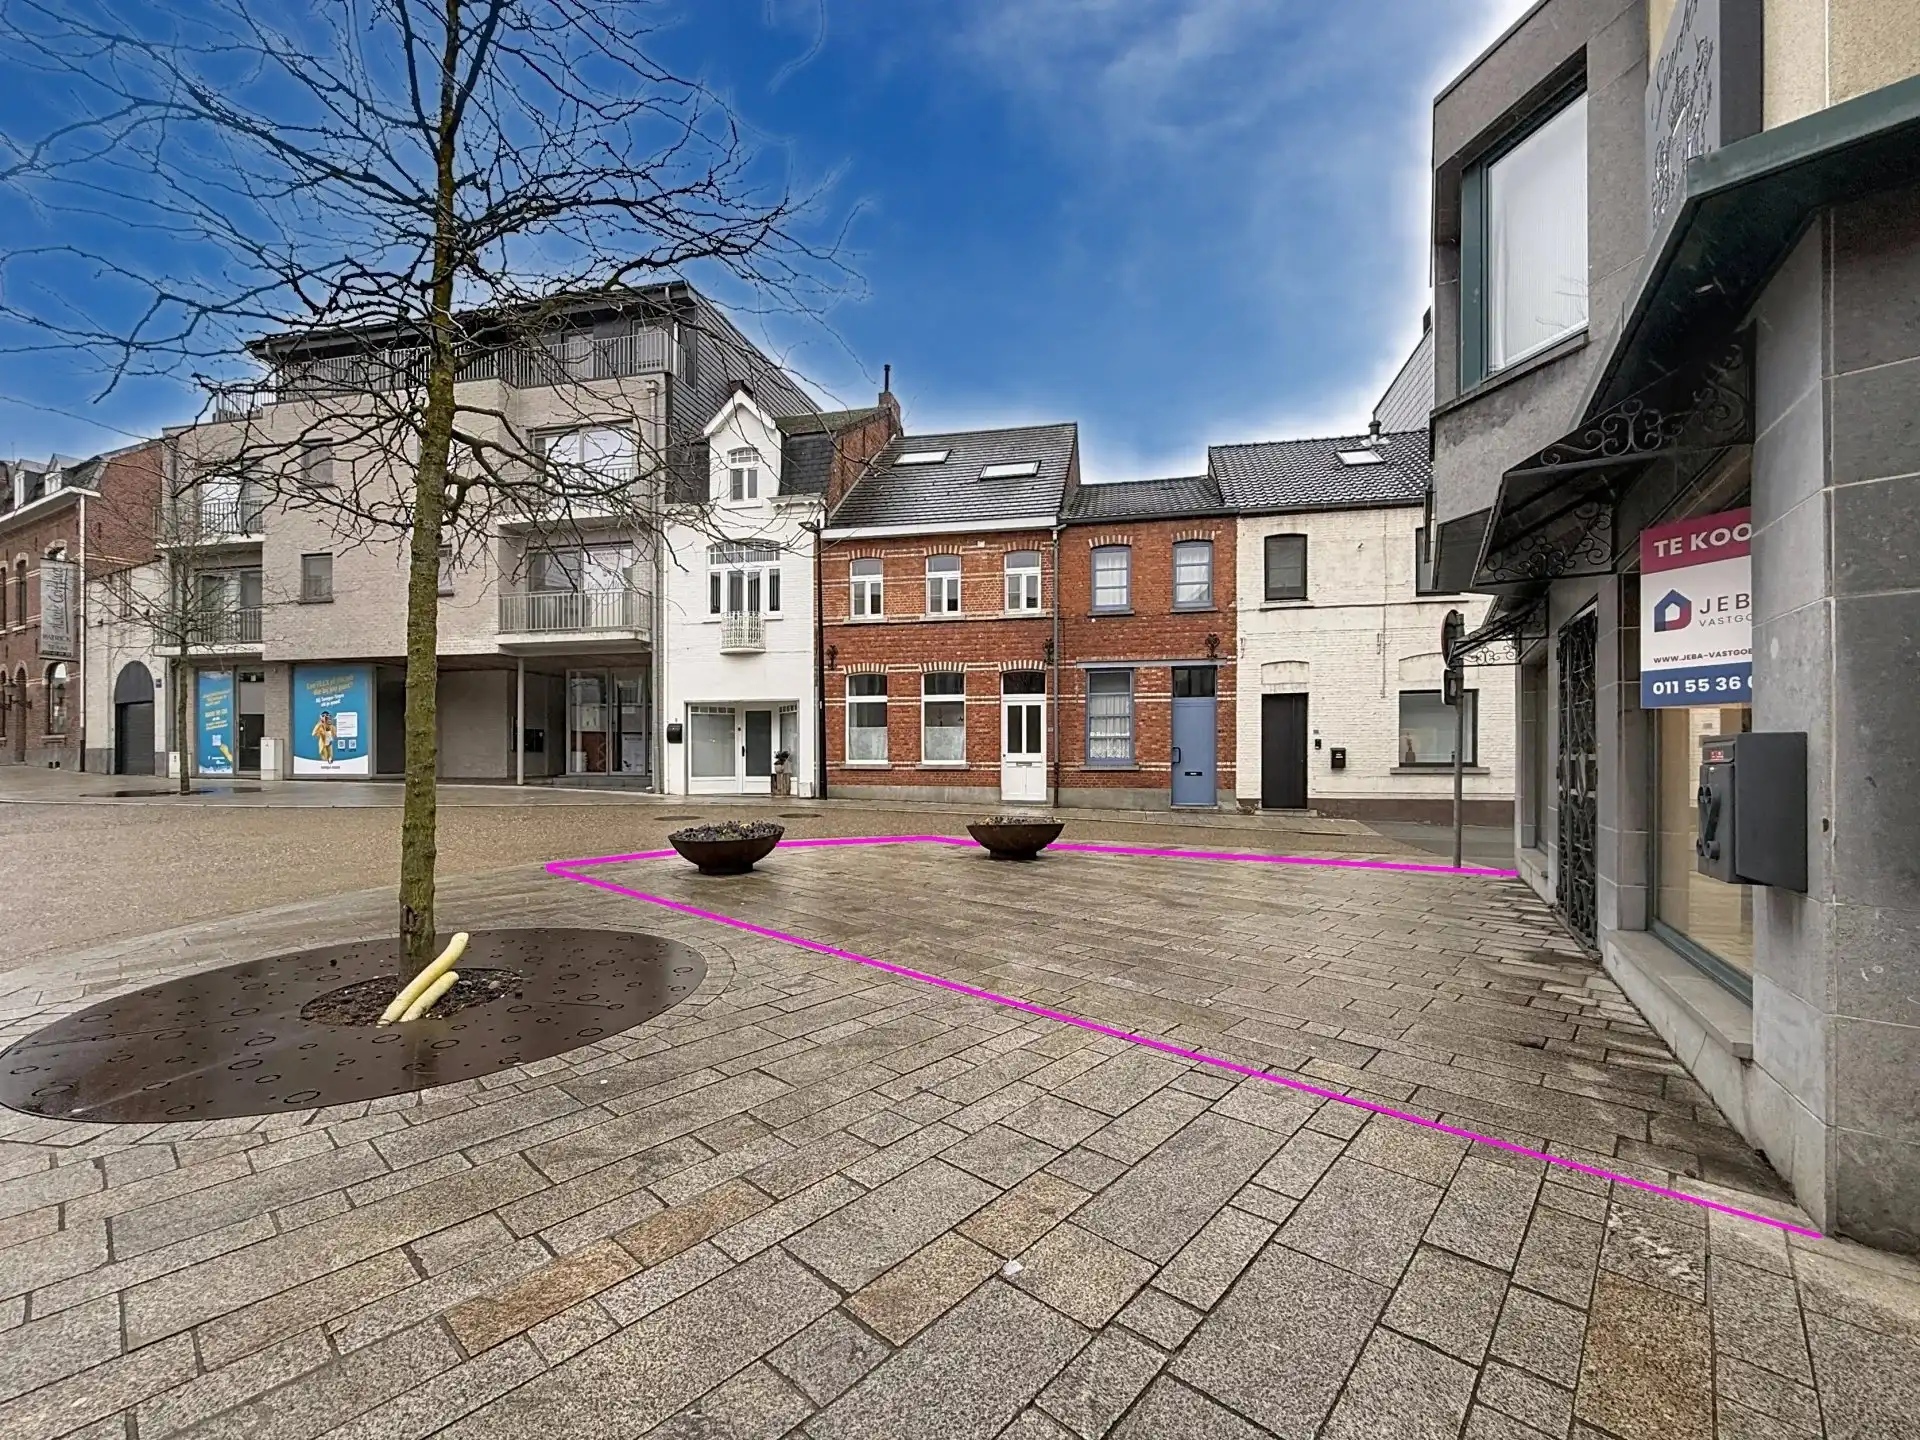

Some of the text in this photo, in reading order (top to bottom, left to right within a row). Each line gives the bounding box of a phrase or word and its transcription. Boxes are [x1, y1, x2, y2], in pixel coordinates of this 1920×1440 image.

[1653, 523, 1752, 558] TE KOO
[1699, 593, 1750, 614] JEB
[1652, 681, 1679, 695] 011
[1685, 678, 1710, 693] 55
[1715, 676, 1741, 691] 36
